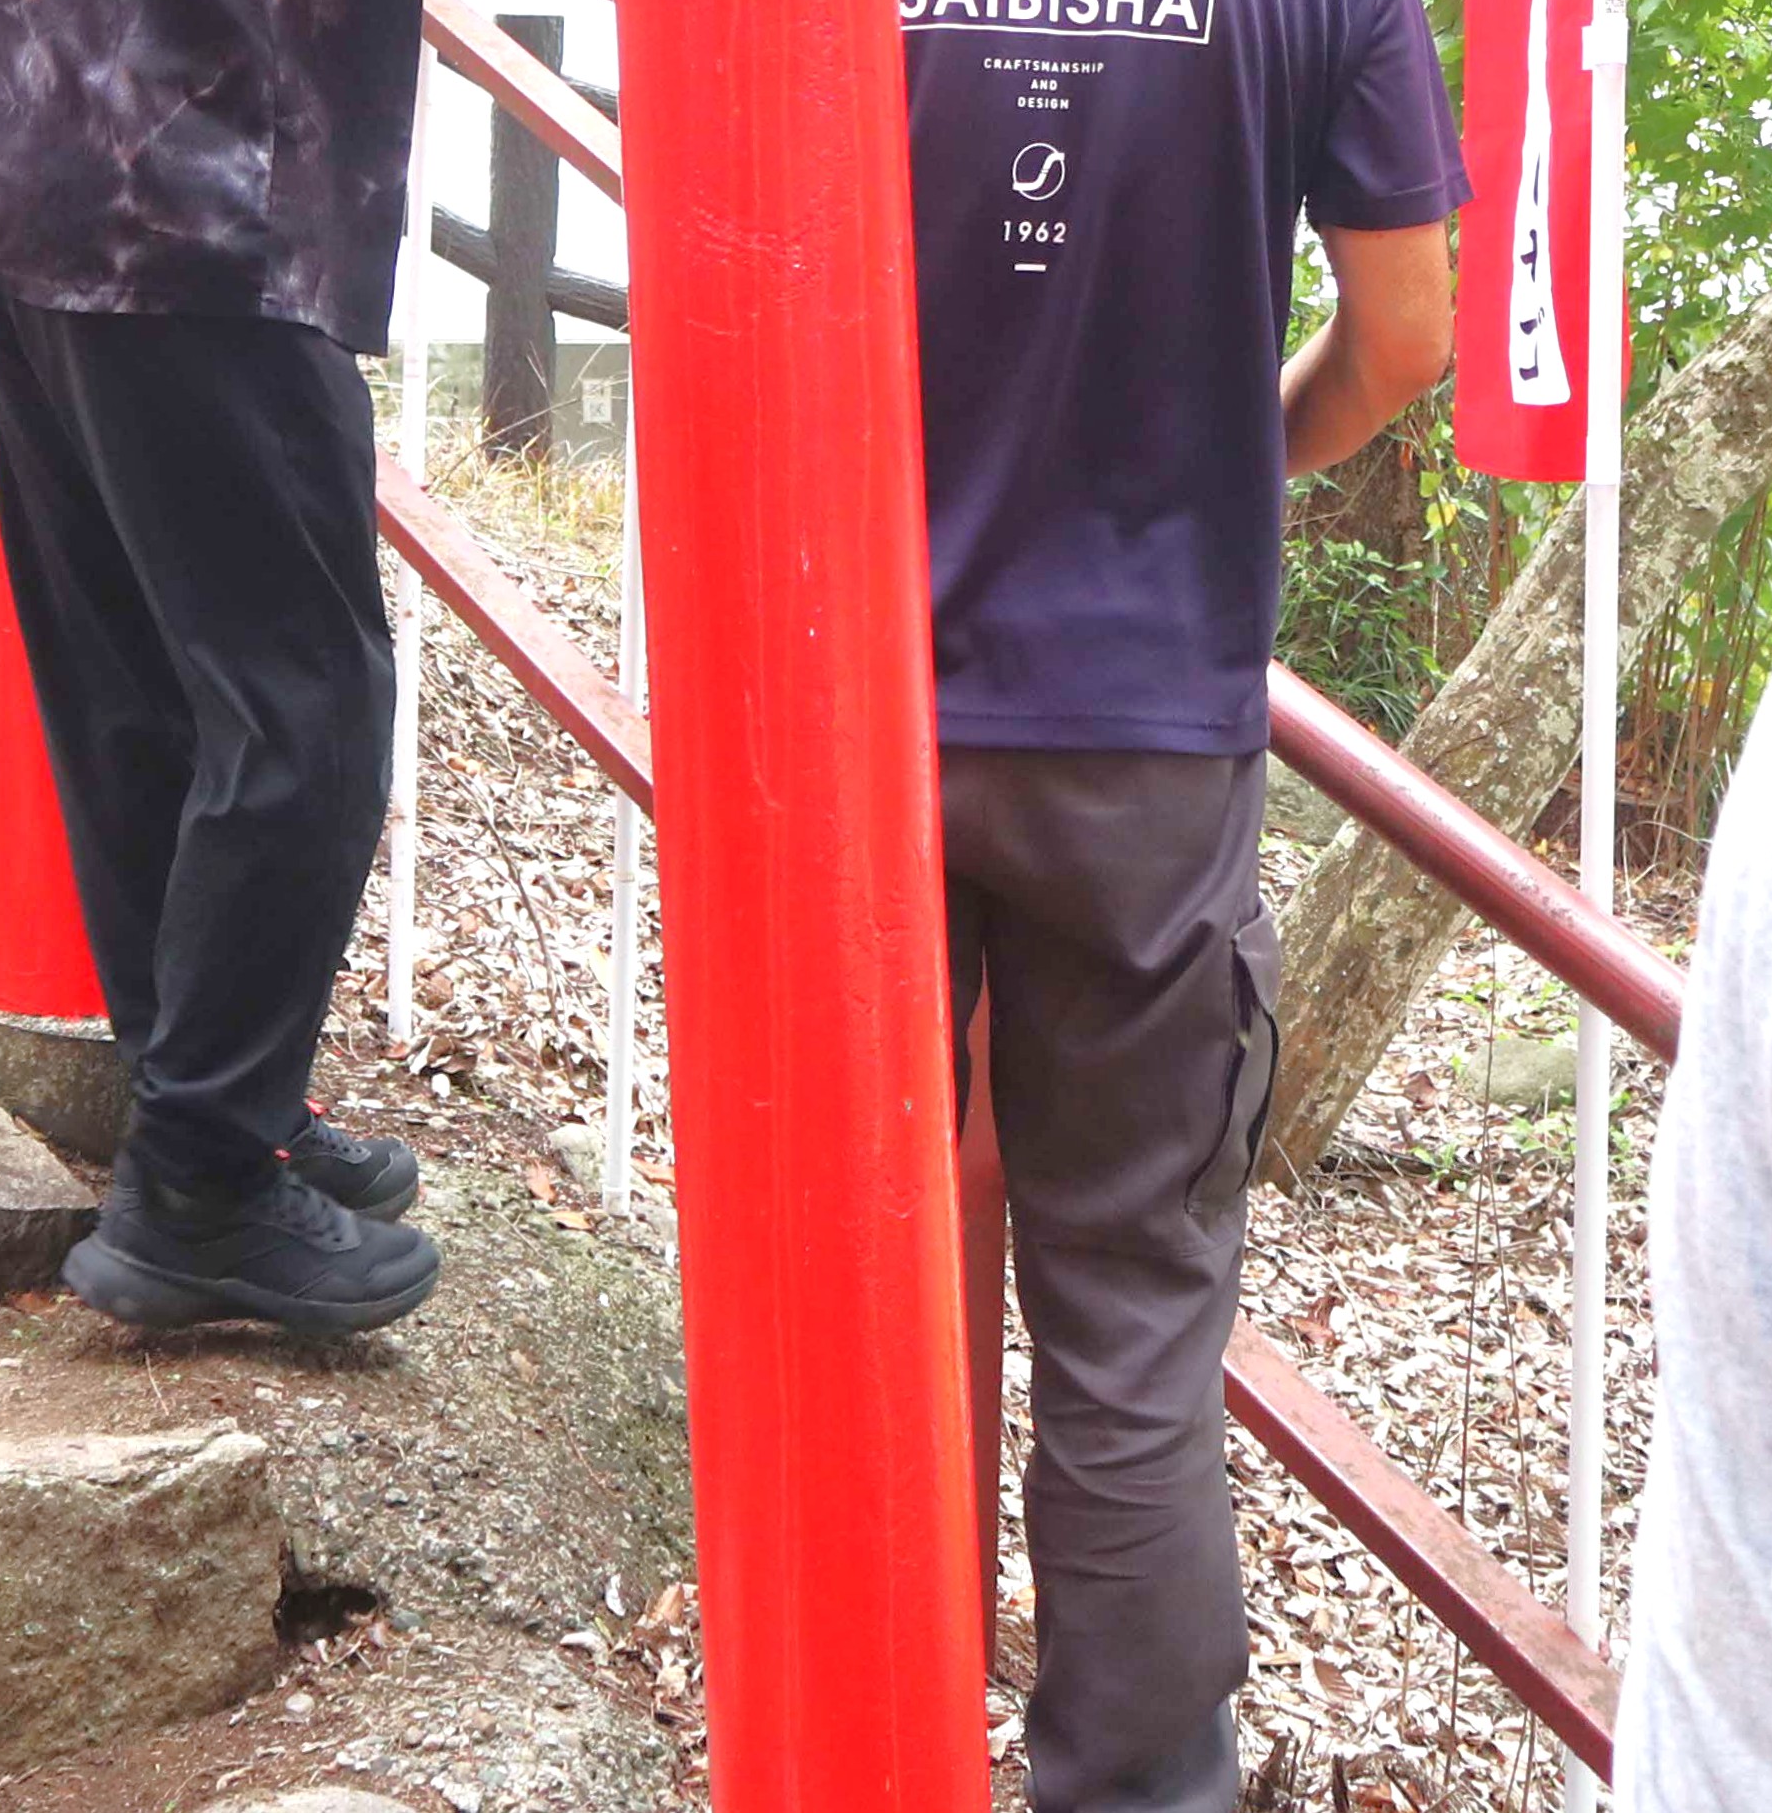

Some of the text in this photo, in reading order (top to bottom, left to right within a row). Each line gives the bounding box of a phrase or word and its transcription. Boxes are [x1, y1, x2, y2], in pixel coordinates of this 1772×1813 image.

[983, 57, 1105, 74] CRAFTSMANSHIP
[1030, 78, 1058, 91] AND
[1017, 96, 1070, 110] DESIGN
[1002, 220, 1067, 244] 1962
